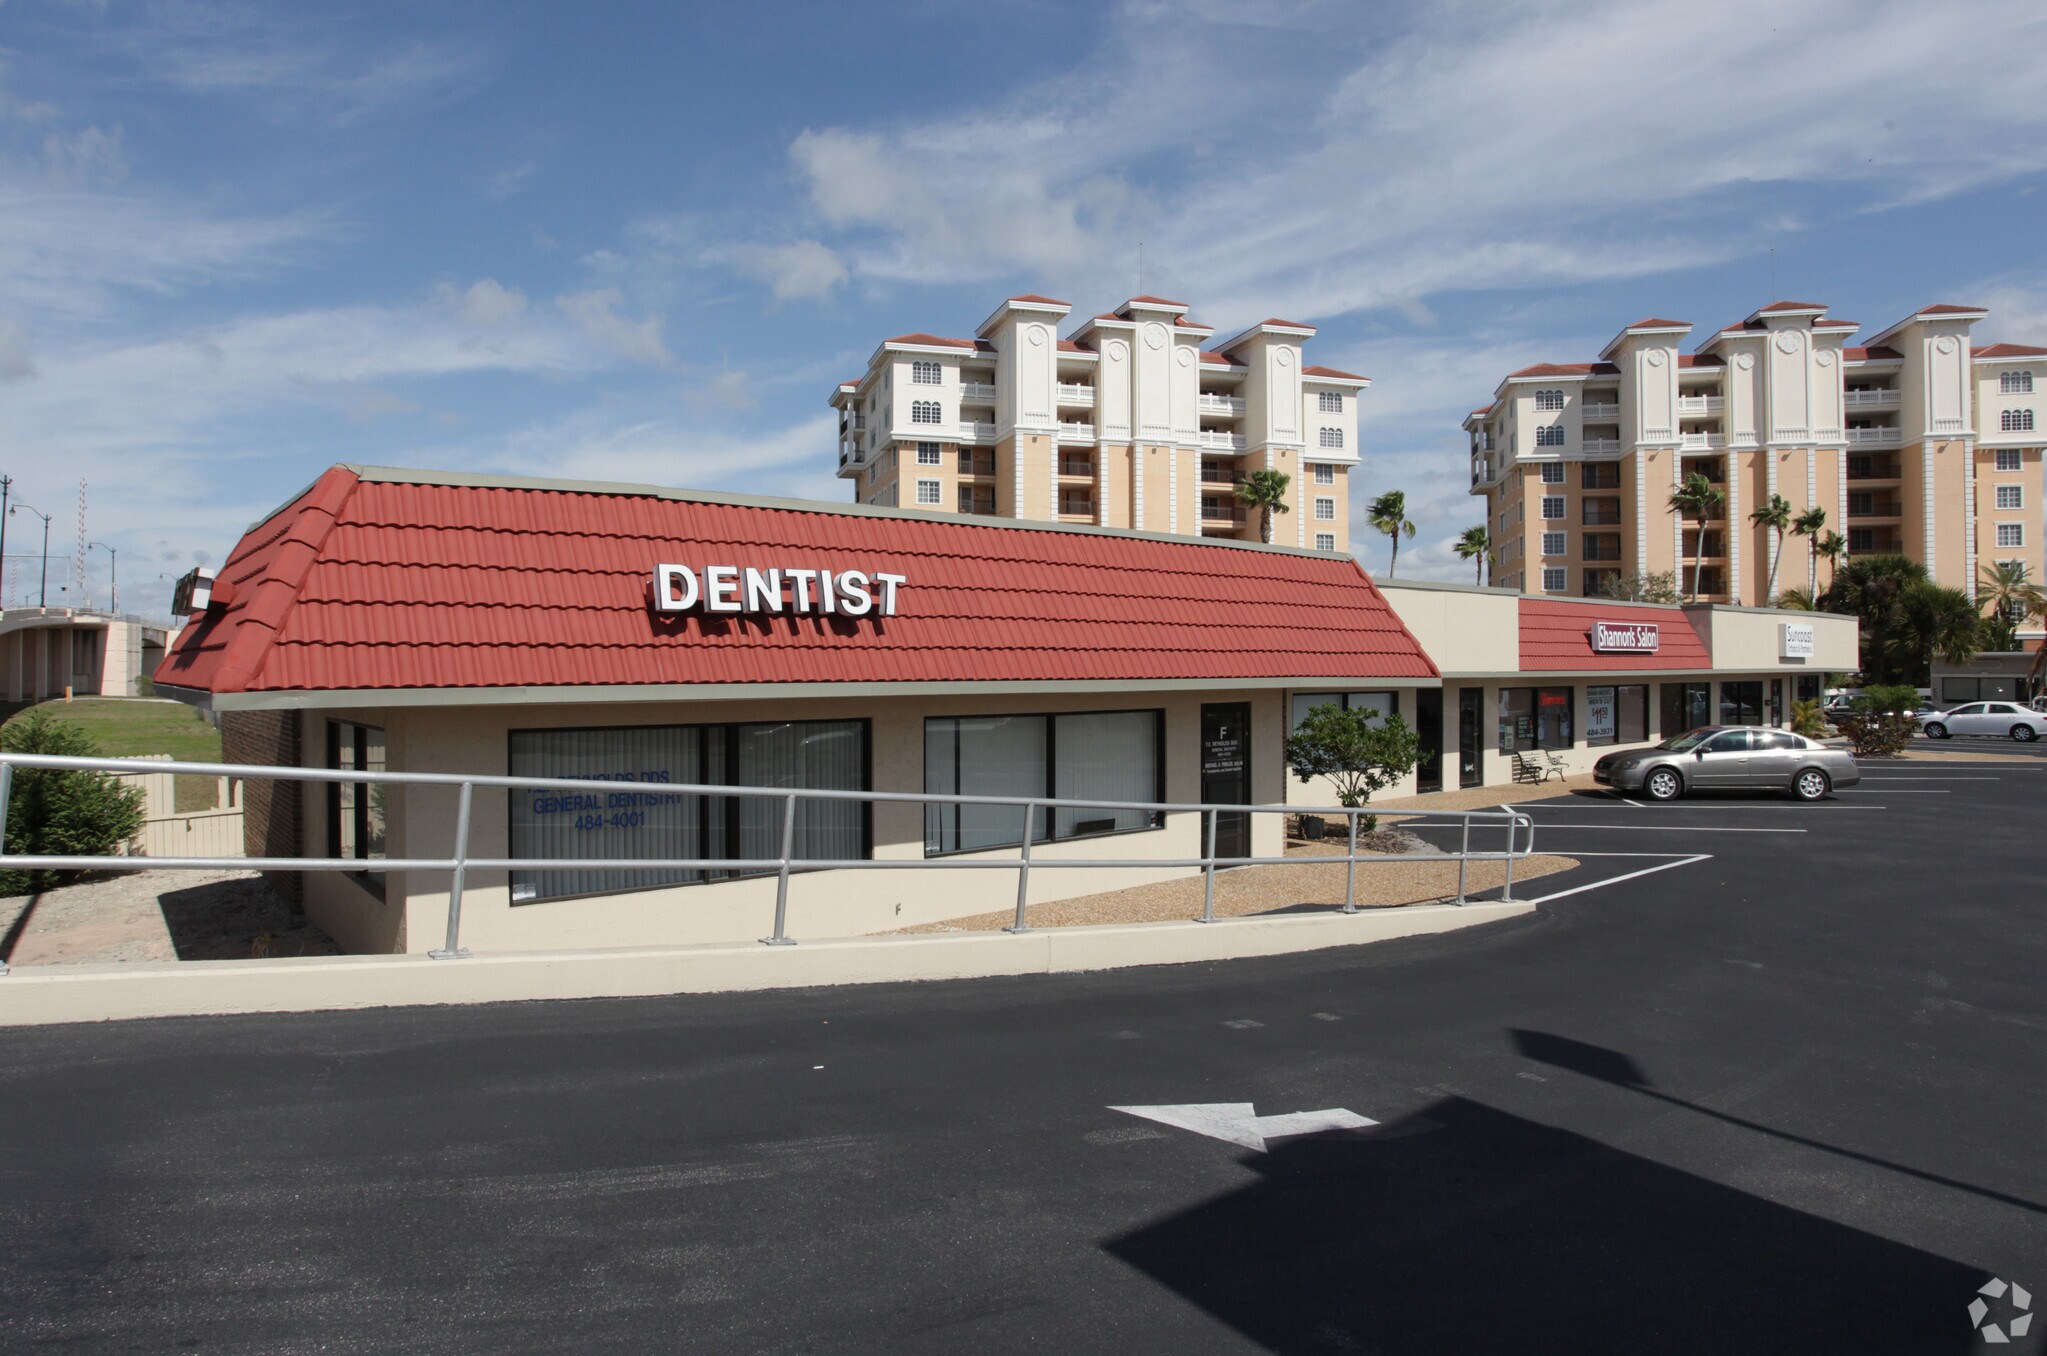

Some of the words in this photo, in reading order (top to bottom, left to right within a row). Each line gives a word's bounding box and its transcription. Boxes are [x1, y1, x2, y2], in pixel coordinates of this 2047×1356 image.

[653, 563, 906, 616] DENTIST
[1599, 625, 1635, 647] Shannon's
[1637, 626, 1657, 647] Salon
[1220, 726, 1227, 740] F
[1586, 727, 1613, 736] 484-3931
[640, 770, 670, 785] DDS
[533, 794, 601, 814] GENERAL
[608, 792, 682, 809] DENTISTRY
[574, 811, 645, 831] 484-4001
